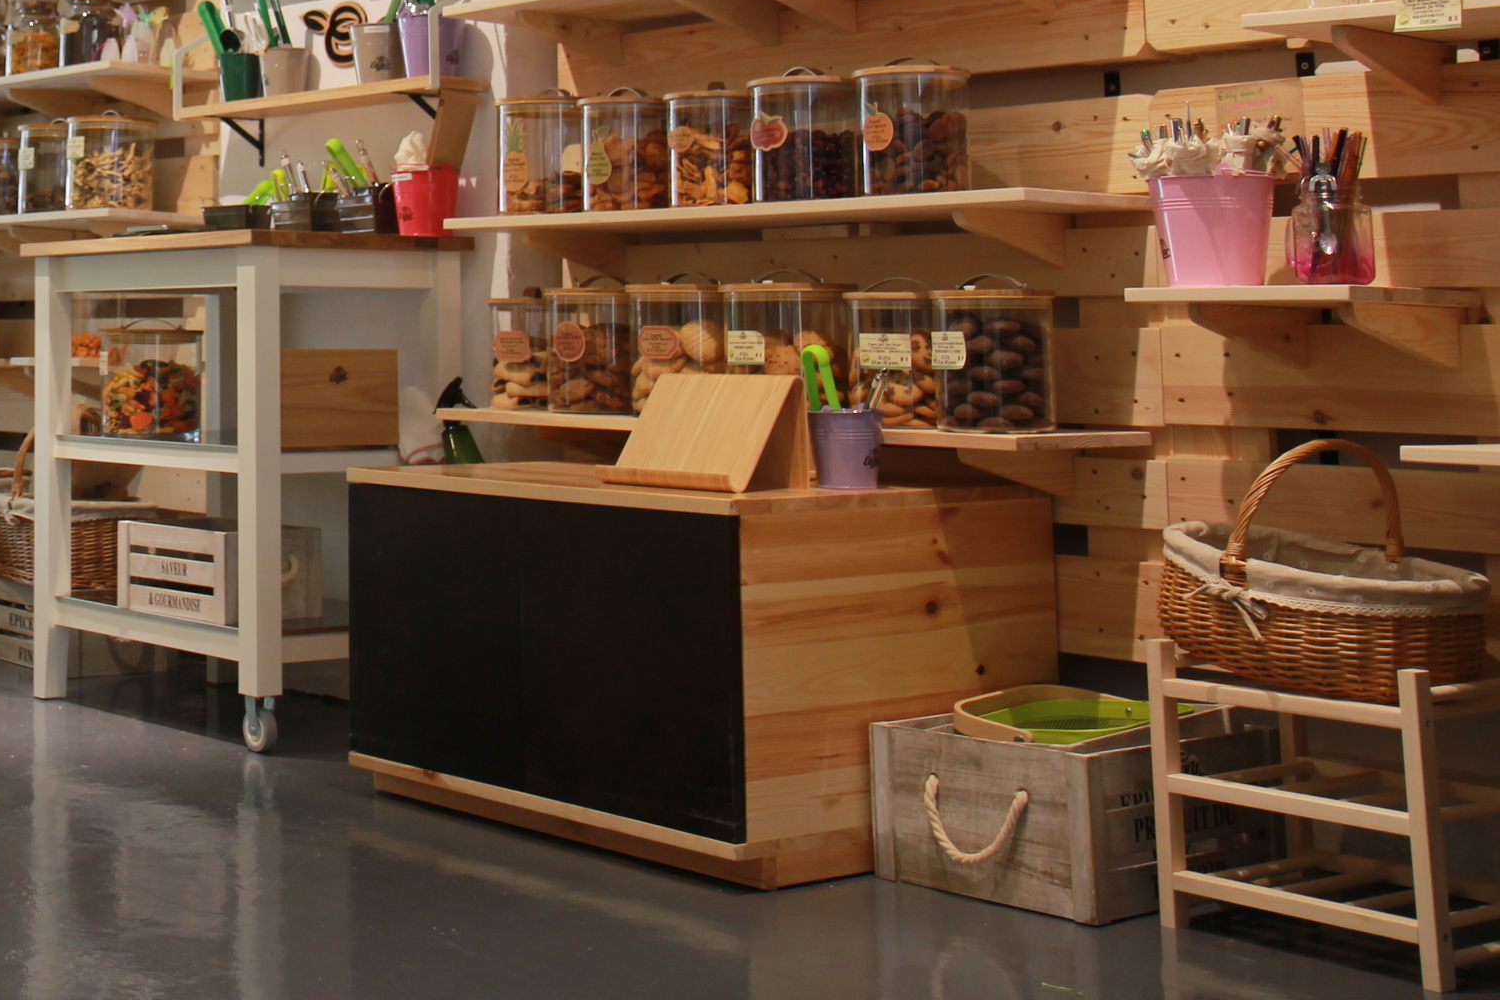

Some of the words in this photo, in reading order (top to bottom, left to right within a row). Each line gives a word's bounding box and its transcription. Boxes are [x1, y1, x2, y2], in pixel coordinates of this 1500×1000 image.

[160, 561, 188, 577] SAVEUR
[154, 592, 201, 612] GOURMANDISE
[1134, 806, 1209, 843] PRUIT
